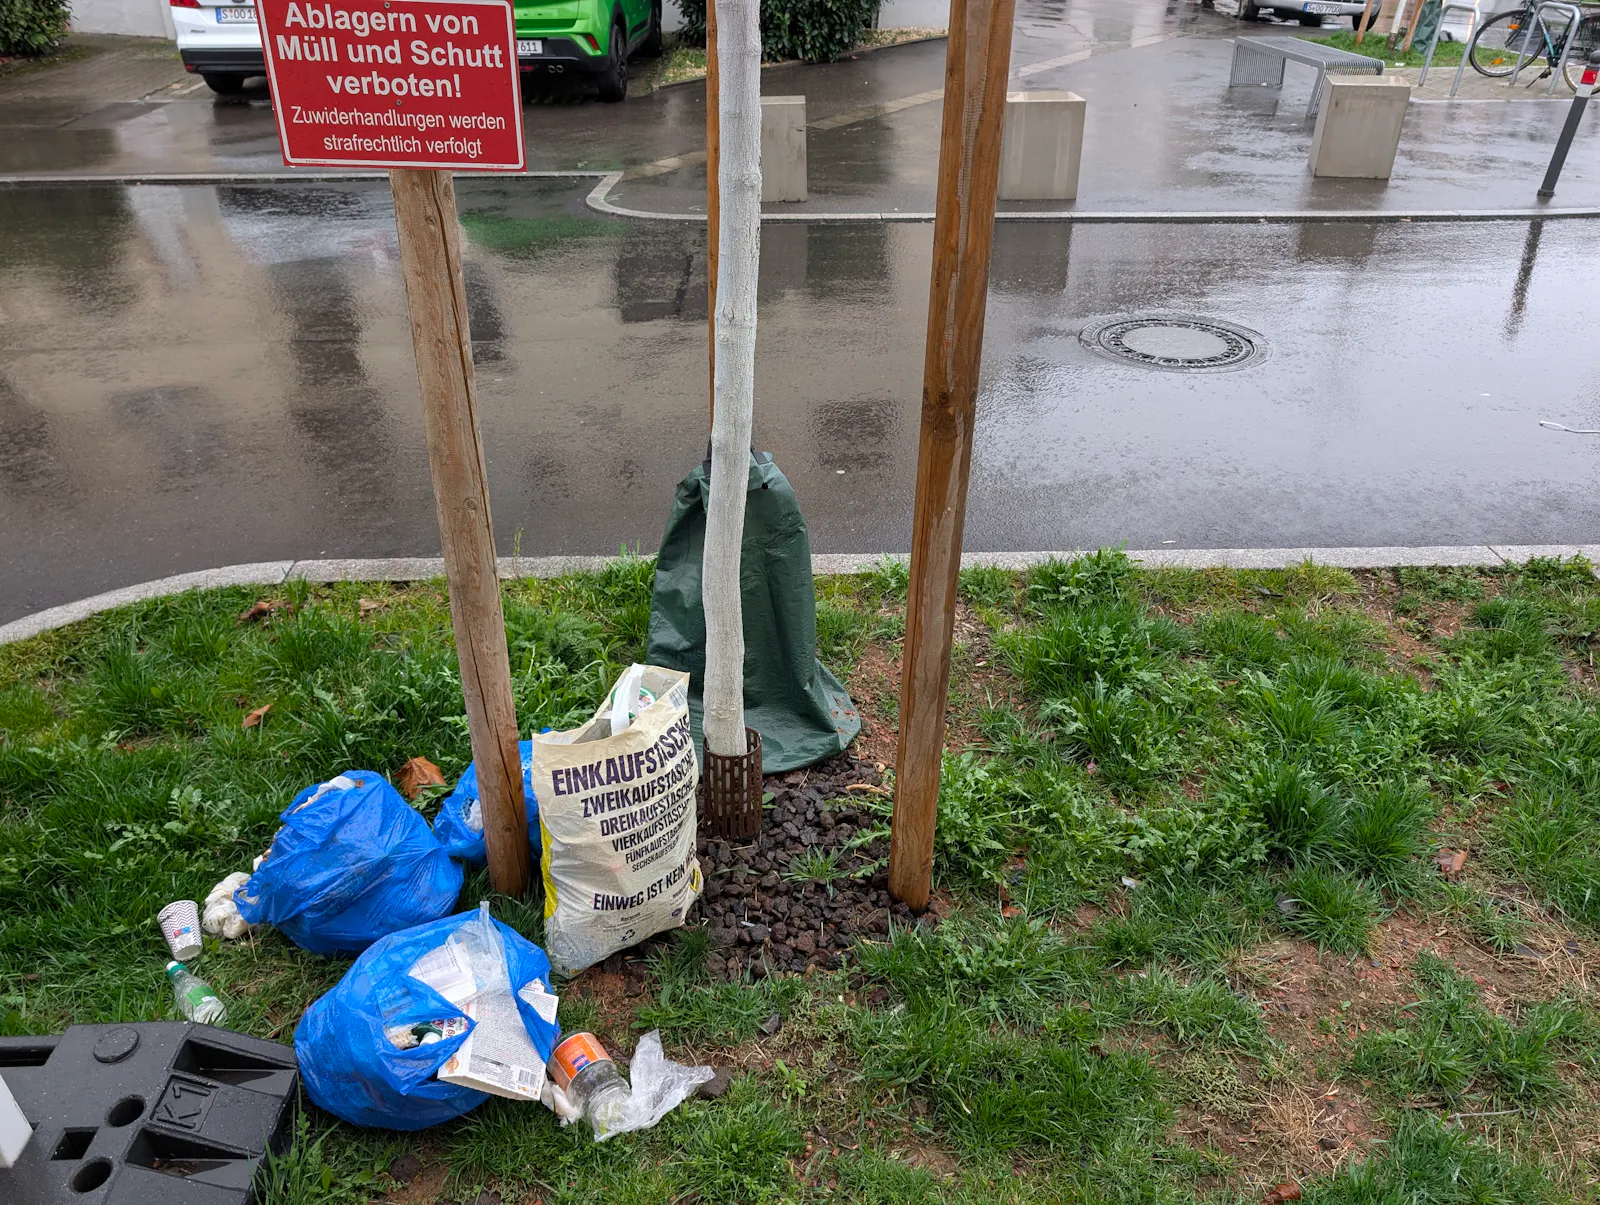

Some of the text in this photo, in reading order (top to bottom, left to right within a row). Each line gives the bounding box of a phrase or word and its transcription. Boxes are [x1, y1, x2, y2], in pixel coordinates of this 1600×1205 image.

[285, 2, 479, 37] Ablagern von
[276, 34, 504, 68] Müll und Schutt
[520, 41, 538, 52] 611
[326, 71, 461, 98] verboten!
[291, 105, 505, 132] Zuwiderhandlungen werden
[324, 134, 482, 159] strafrechtlich verfolgt
[551, 713, 691, 796] EINKAUFSTASCHE
[580, 748, 695, 819] ZWEIKAUFSTASCHE
[600, 775, 695, 837] DREIKAUFSTASCHE
[593, 891, 645, 911] EINWEG
[647, 878, 663, 901] IST
[665, 862, 685, 889] KEIN
